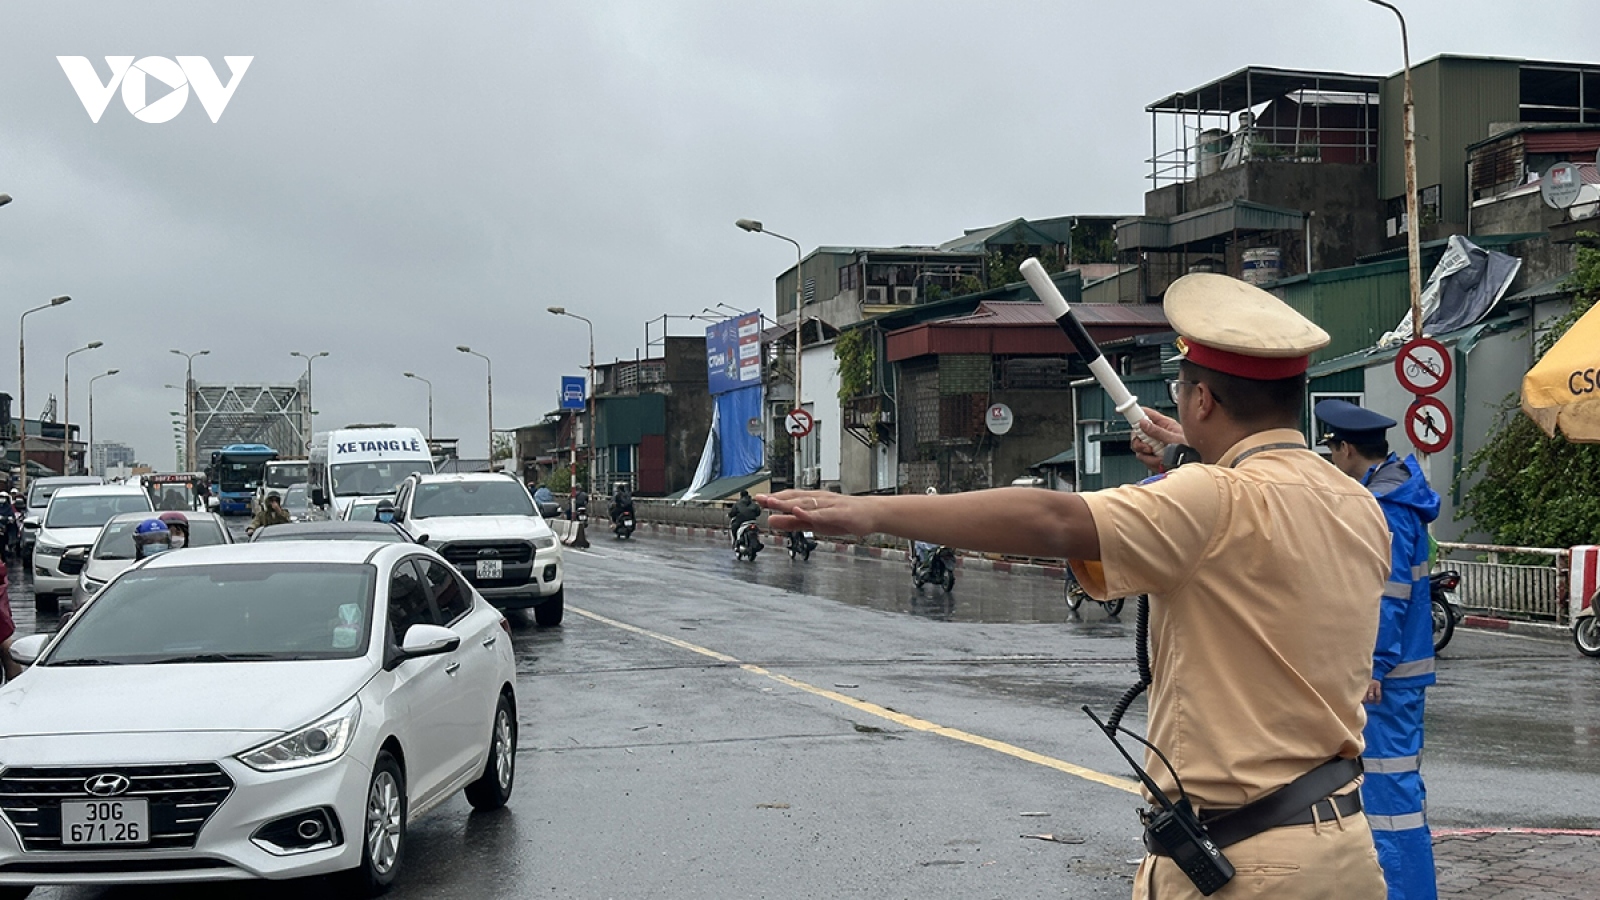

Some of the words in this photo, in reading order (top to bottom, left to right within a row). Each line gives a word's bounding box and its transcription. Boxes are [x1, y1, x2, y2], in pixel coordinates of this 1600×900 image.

[337, 442, 357, 454] XE
[358, 440, 400, 452] TANG
[86, 803, 123, 821] 30G
[71, 823, 139, 842] 671.26
